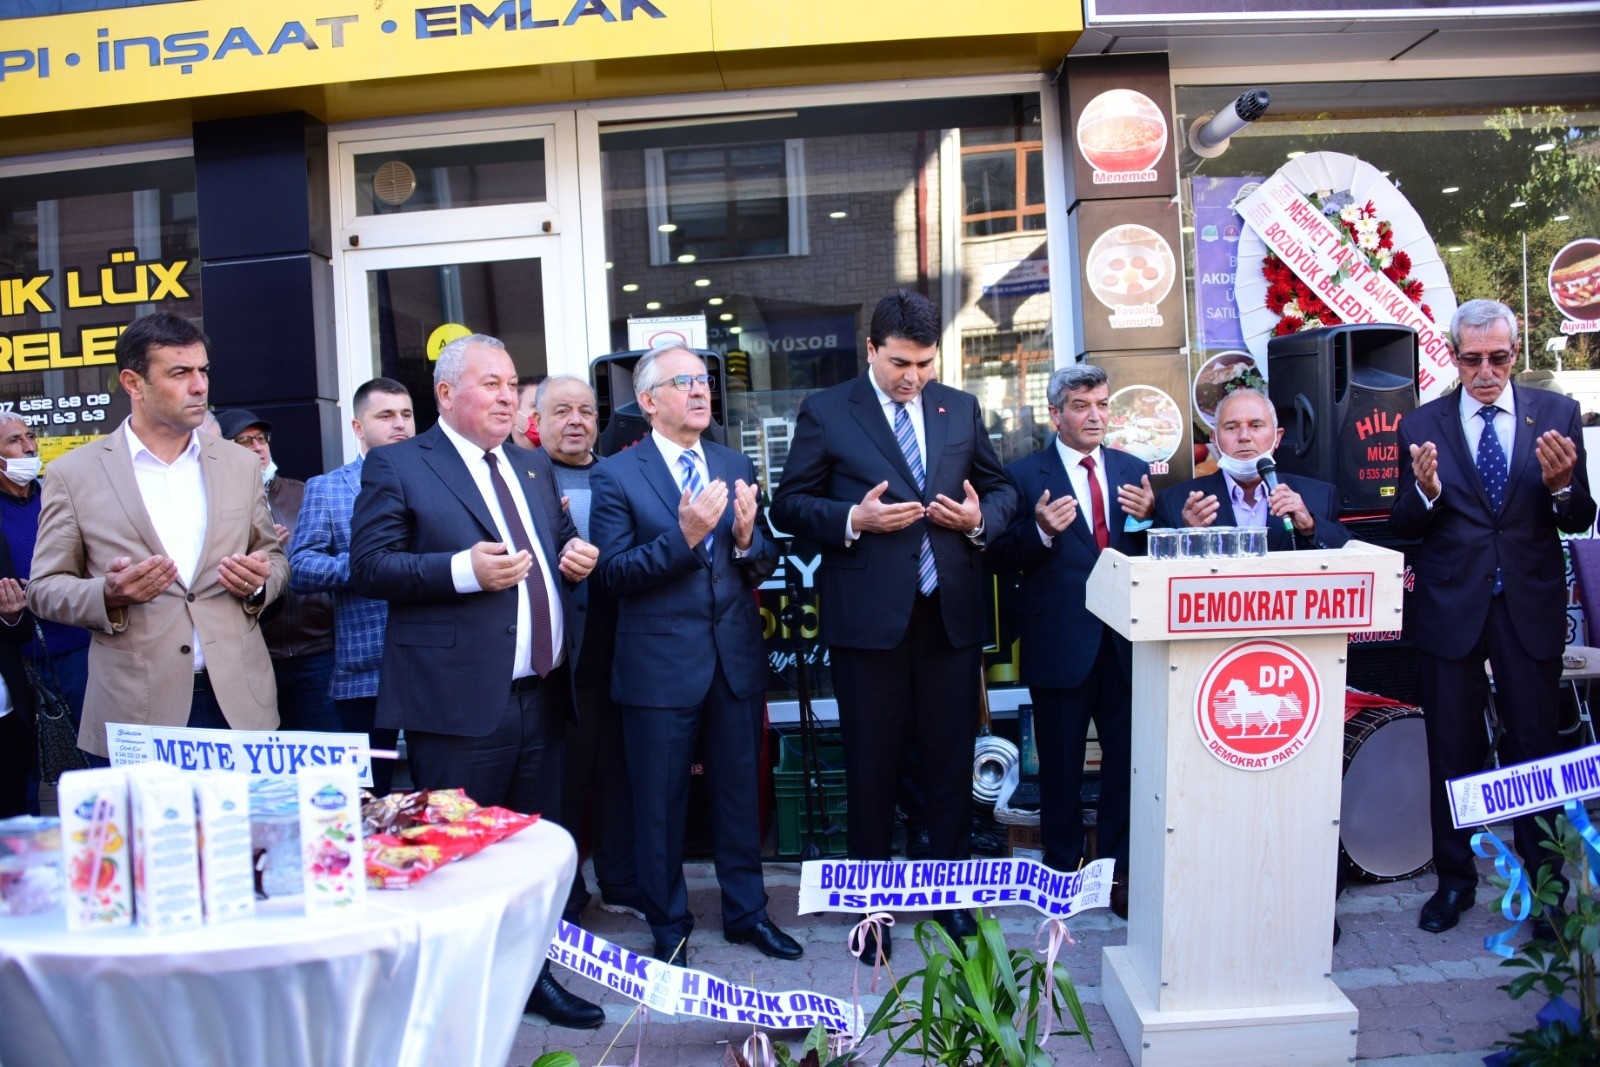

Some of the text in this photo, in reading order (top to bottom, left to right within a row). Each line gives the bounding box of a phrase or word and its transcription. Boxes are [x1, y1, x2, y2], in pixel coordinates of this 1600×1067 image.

[415, 0, 668, 39] EMLAK
[1094, 171, 1156, 183] Menemen
[1284, 199, 1334, 246] MEHMET
[1264, 222, 1323, 282] BOZÜYÜK
[67, 251, 190, 308] LÜX
[0, 325, 128, 372] RELE
[20, 399, 53, 411] 652
[58, 396, 81, 408] 68
[53, 412, 76, 423] 63
[82, 409, 105, 421] 63
[1367, 443, 1399, 461] MÜZİ
[1178, 580, 1366, 623] DEMOKRAT PARTİ
[1259, 665, 1294, 688] DP
[153, 738, 235, 771] METE
[1209, 738, 1304, 768] DEMOKRAT PARTİ
[1481, 756, 1600, 814] BOZÜYÜK MUH
[821, 860, 907, 890] BOZÜYÜK
[911, 858, 1011, 887] ENGELLİLER
[828, 889, 961, 908] İSMAİL
[547, 943, 602, 981] SELİM
[607, 972, 645, 1001] GÜN
[675, 997, 728, 1020] TİH
[737, 1009, 848, 1031] KAYRAK
[707, 977, 783, 1013] MÜZİK
[789, 993, 845, 1019] ORG.
